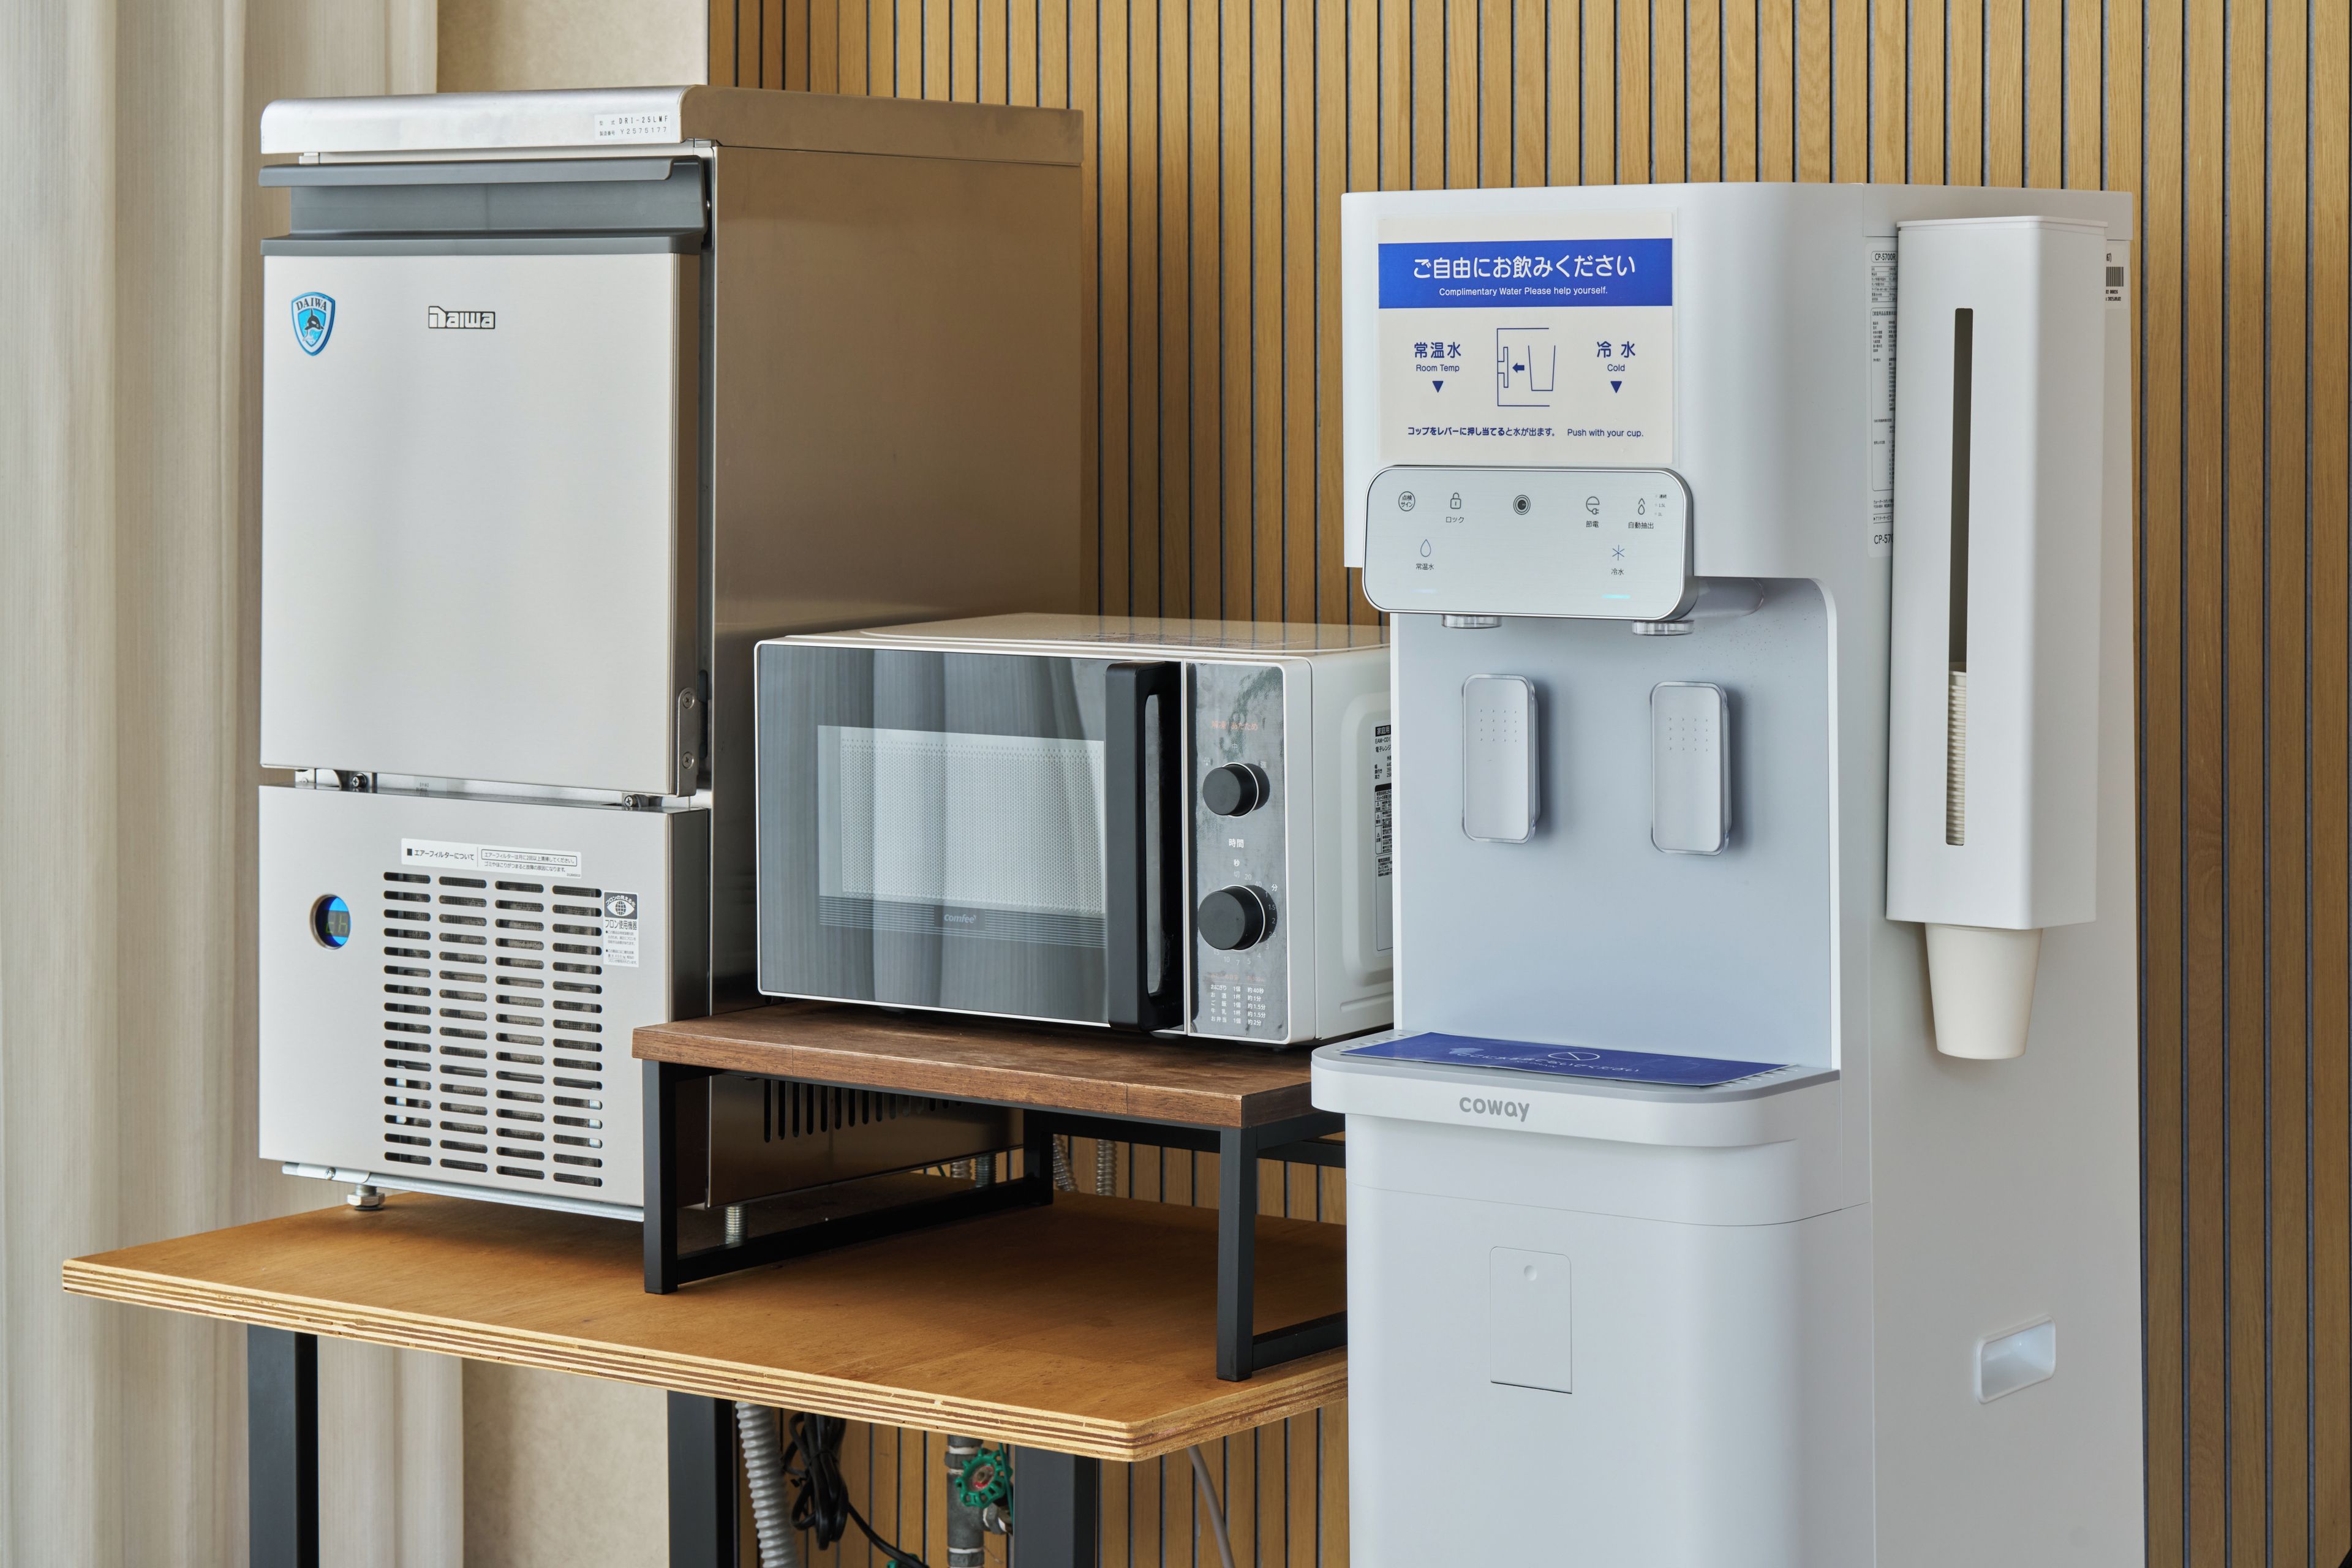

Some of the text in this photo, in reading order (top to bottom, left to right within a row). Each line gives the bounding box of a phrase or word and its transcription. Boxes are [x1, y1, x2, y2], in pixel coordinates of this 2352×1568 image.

[1414, 254, 1635, 279] ご自由にお飲みください
[1439, 287, 1497, 297] Complimentary
[1499, 287, 1522, 295] Water
[1554, 286, 1571, 296] help
[1574, 286, 1608, 296] yourself.
[296, 298, 327, 311] DAIWA
[1414, 342, 1461, 358] 常温水
[1597, 341, 1636, 358] 冷水
[1440, 364, 1460, 373] Temp
[1408, 427, 1556, 437] コップをレバーに押し当てると水が出ます。
[1229, 839, 1244, 848] 時間
[415, 849, 475, 861] エアーフィルターについて
[605, 895, 636, 907] フロンの見える化
[605, 919, 637, 930] フロン使用機器
[1459, 1097, 1530, 1123] coway
